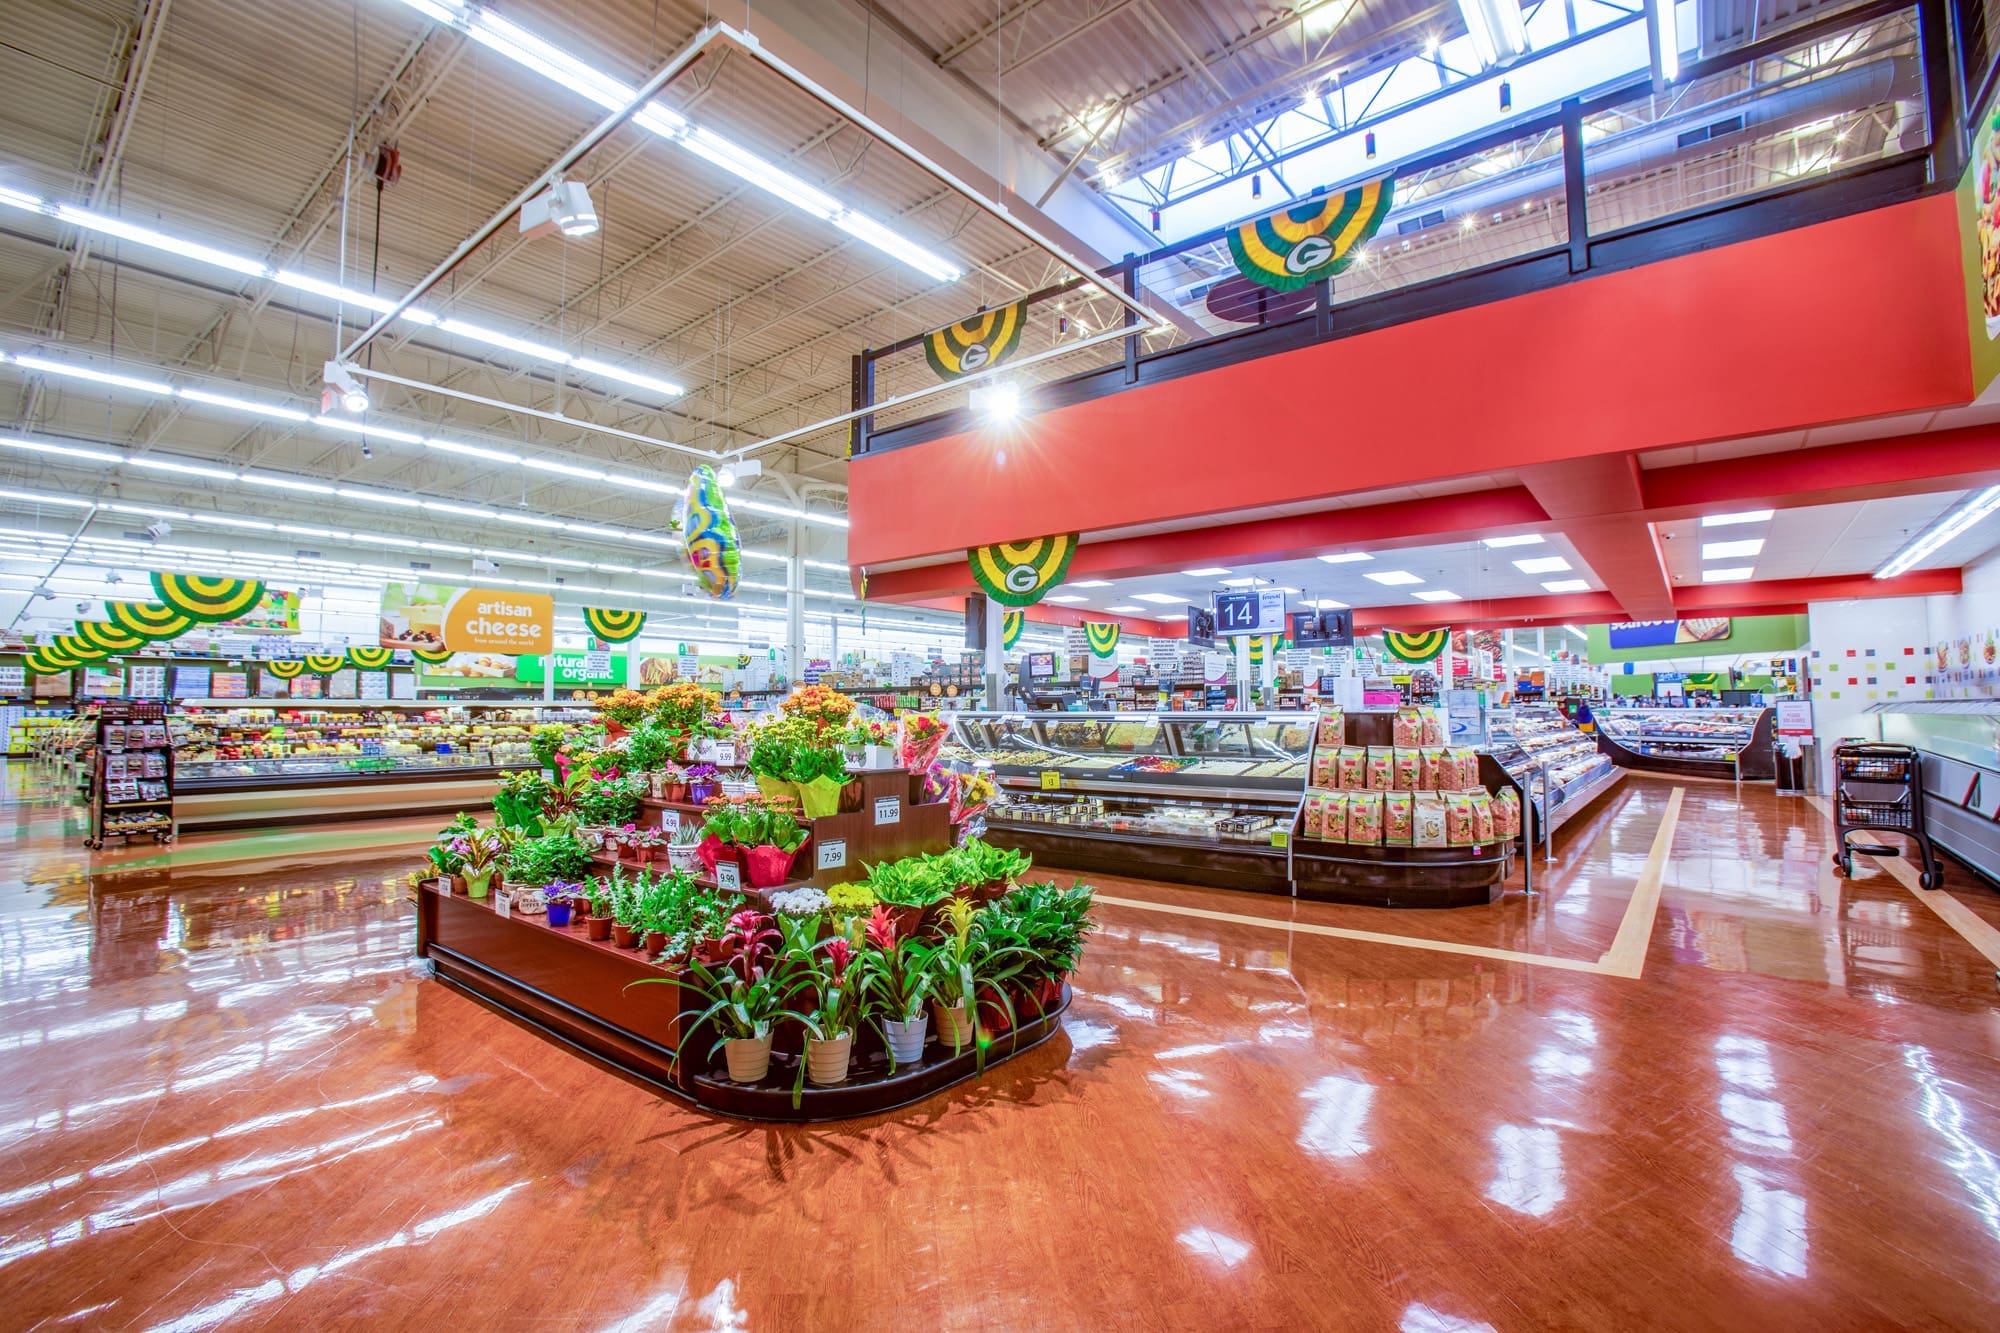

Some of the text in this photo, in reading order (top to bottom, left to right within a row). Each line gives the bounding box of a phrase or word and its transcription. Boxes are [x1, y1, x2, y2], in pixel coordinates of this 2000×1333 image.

[1286, 235, 1334, 275] G
[960, 344, 989, 371] G
[1005, 564, 1039, 593] G
[477, 601, 532, 617] artisan
[1224, 602, 1252, 626] 14
[465, 617, 542, 637] cheese
[538, 654, 588, 668] ntural
[879, 807, 899, 819] 11.99
[824, 851, 842, 863] 7.99
[720, 873, 735, 885] 9.99
